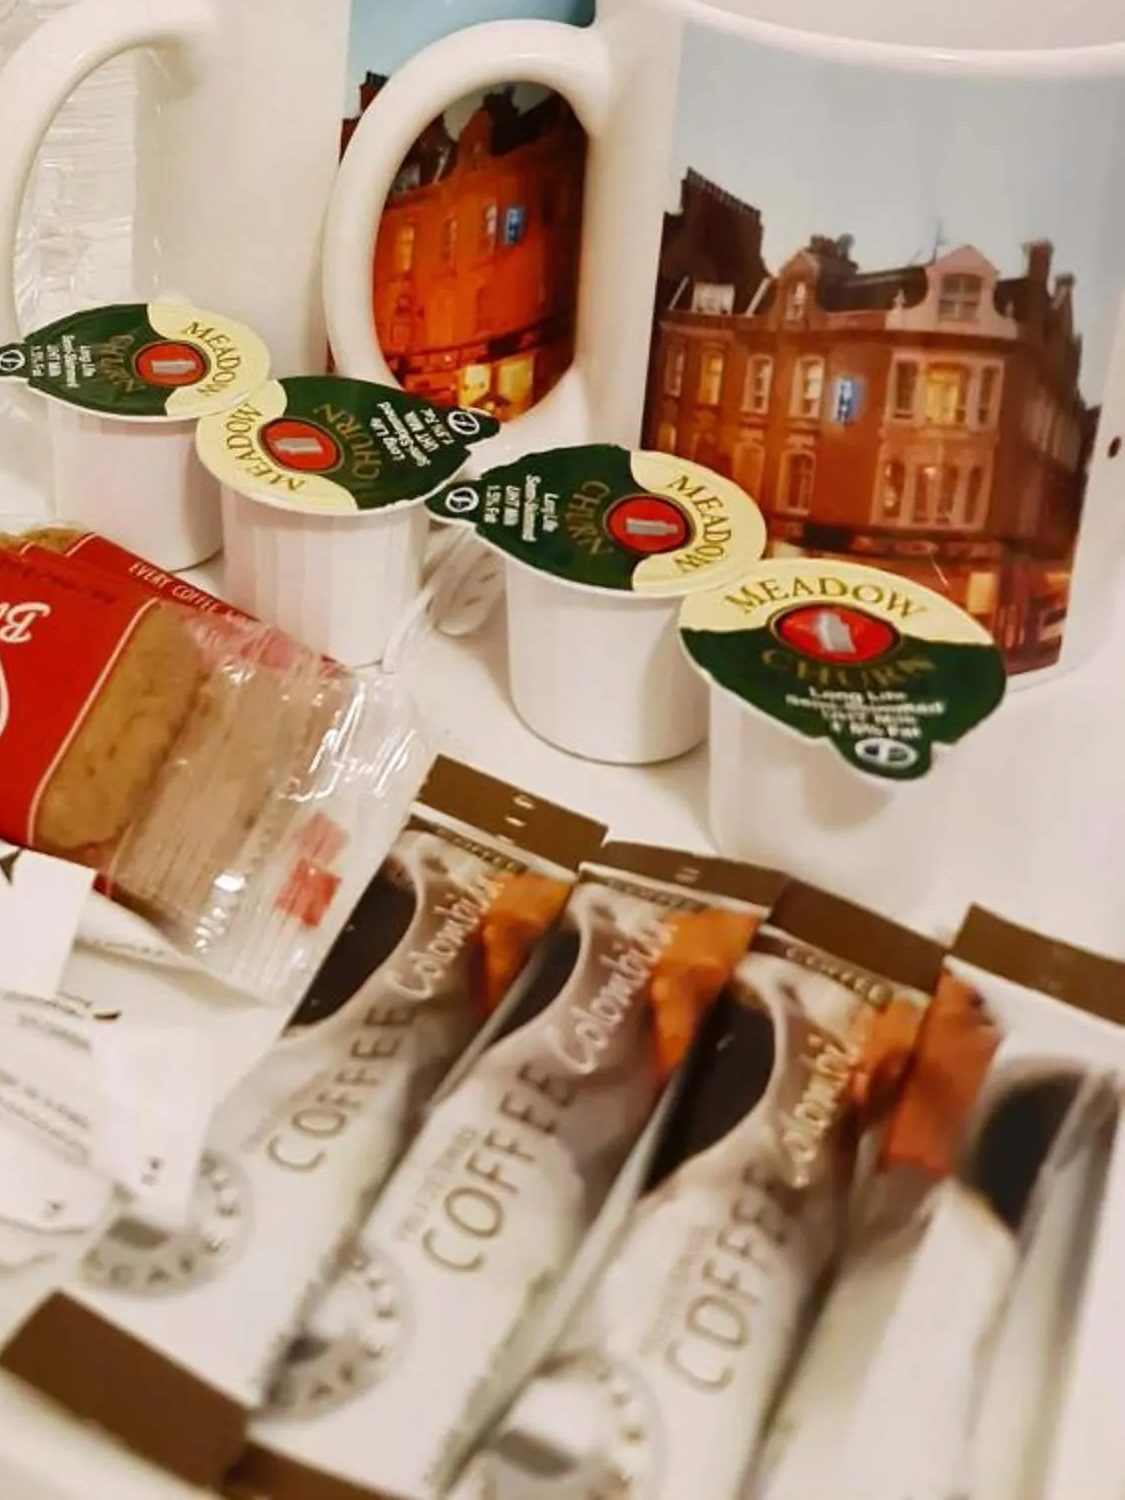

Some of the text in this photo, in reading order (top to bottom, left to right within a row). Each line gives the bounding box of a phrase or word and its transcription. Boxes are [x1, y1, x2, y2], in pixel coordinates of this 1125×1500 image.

[182, 320, 243, 397] MEADOW
[223, 403, 306, 493] MEADOW
[315, 403, 381, 480] CHURN
[668, 473, 735, 574] MEADOW
[725, 576, 928, 620] MEADOW
[269, 1002, 418, 1175] COFFEE
[422, 1058, 577, 1277] COFFEE
[676, 1163, 797, 1394] COFFEE
